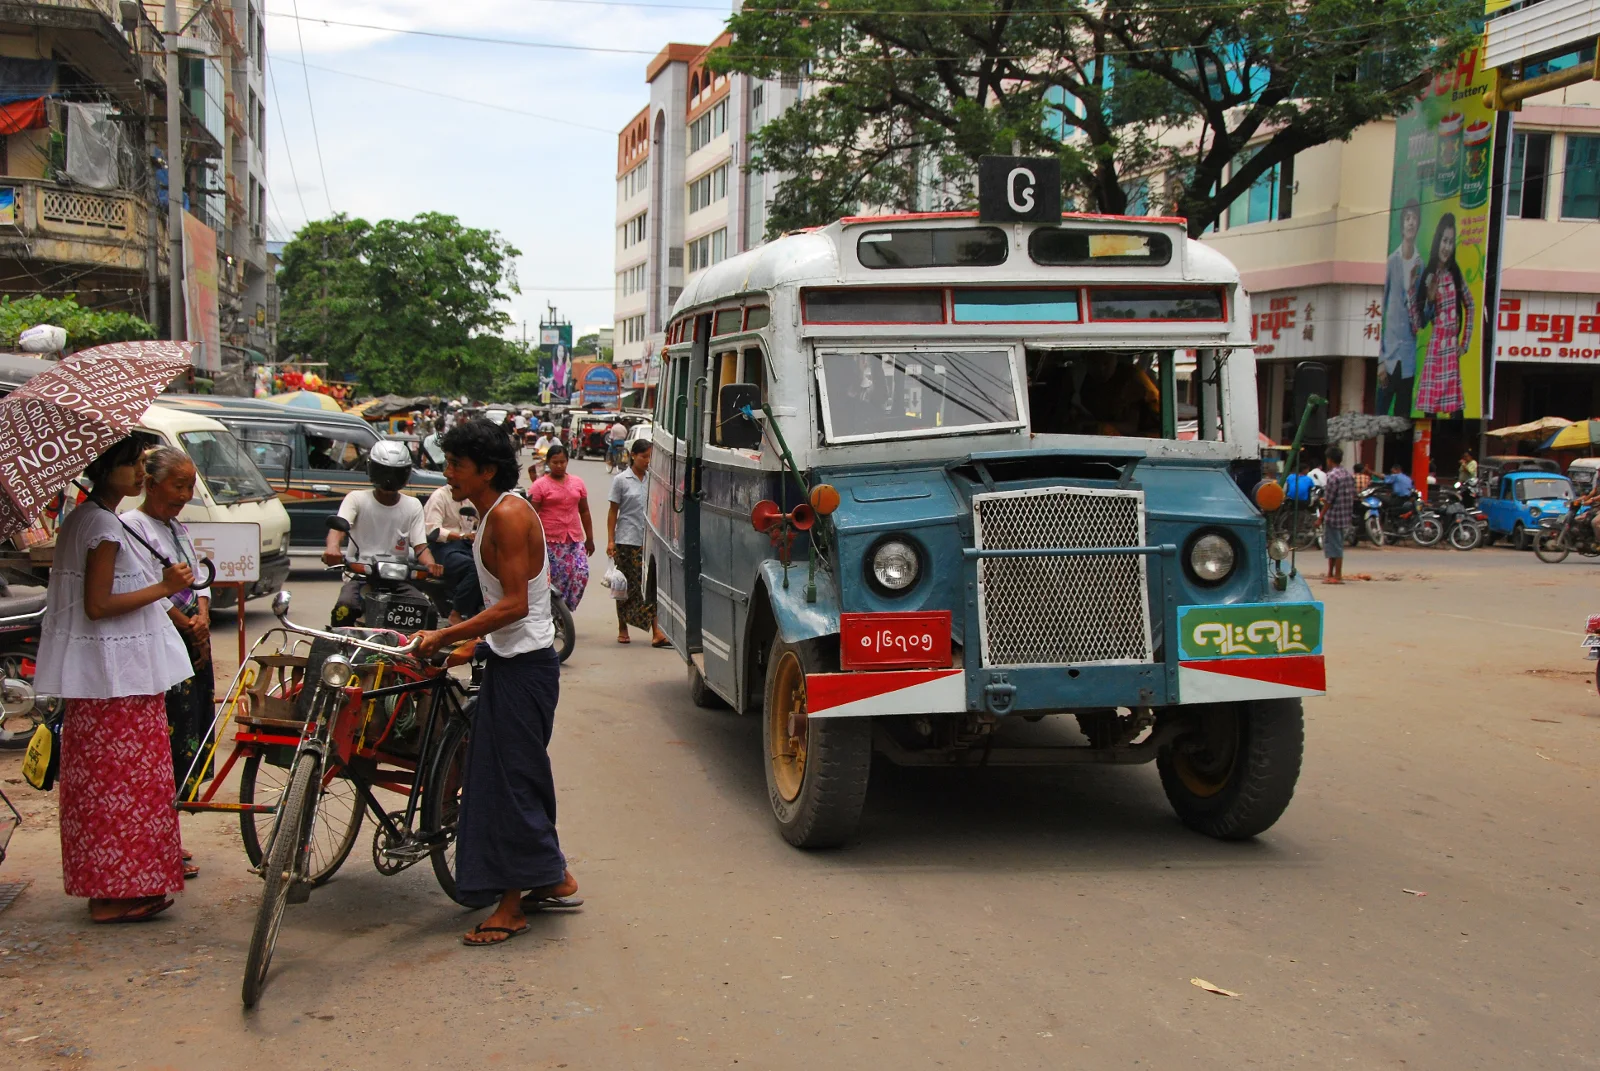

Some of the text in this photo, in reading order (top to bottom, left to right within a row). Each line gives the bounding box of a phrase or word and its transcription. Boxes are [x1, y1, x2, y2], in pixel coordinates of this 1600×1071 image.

[1452, 84, 1488, 102] Battery
[1508, 346, 1551, 357] GOLD
[1558, 347, 1600, 359] SHOP
[79, 360, 114, 376] DREAD
[84, 365, 120, 381] BRAIN
[91, 371, 128, 388] PAIN
[94, 386, 147, 407] ANGER
[123, 397, 155, 412] AIN
[11, 401, 37, 447] EMOTIONS
[26, 400, 54, 439] CRISIS
[37, 453, 84, 480] TENSION
[28, 474, 46, 498] HEART
[47, 480, 67, 494] PAIN
